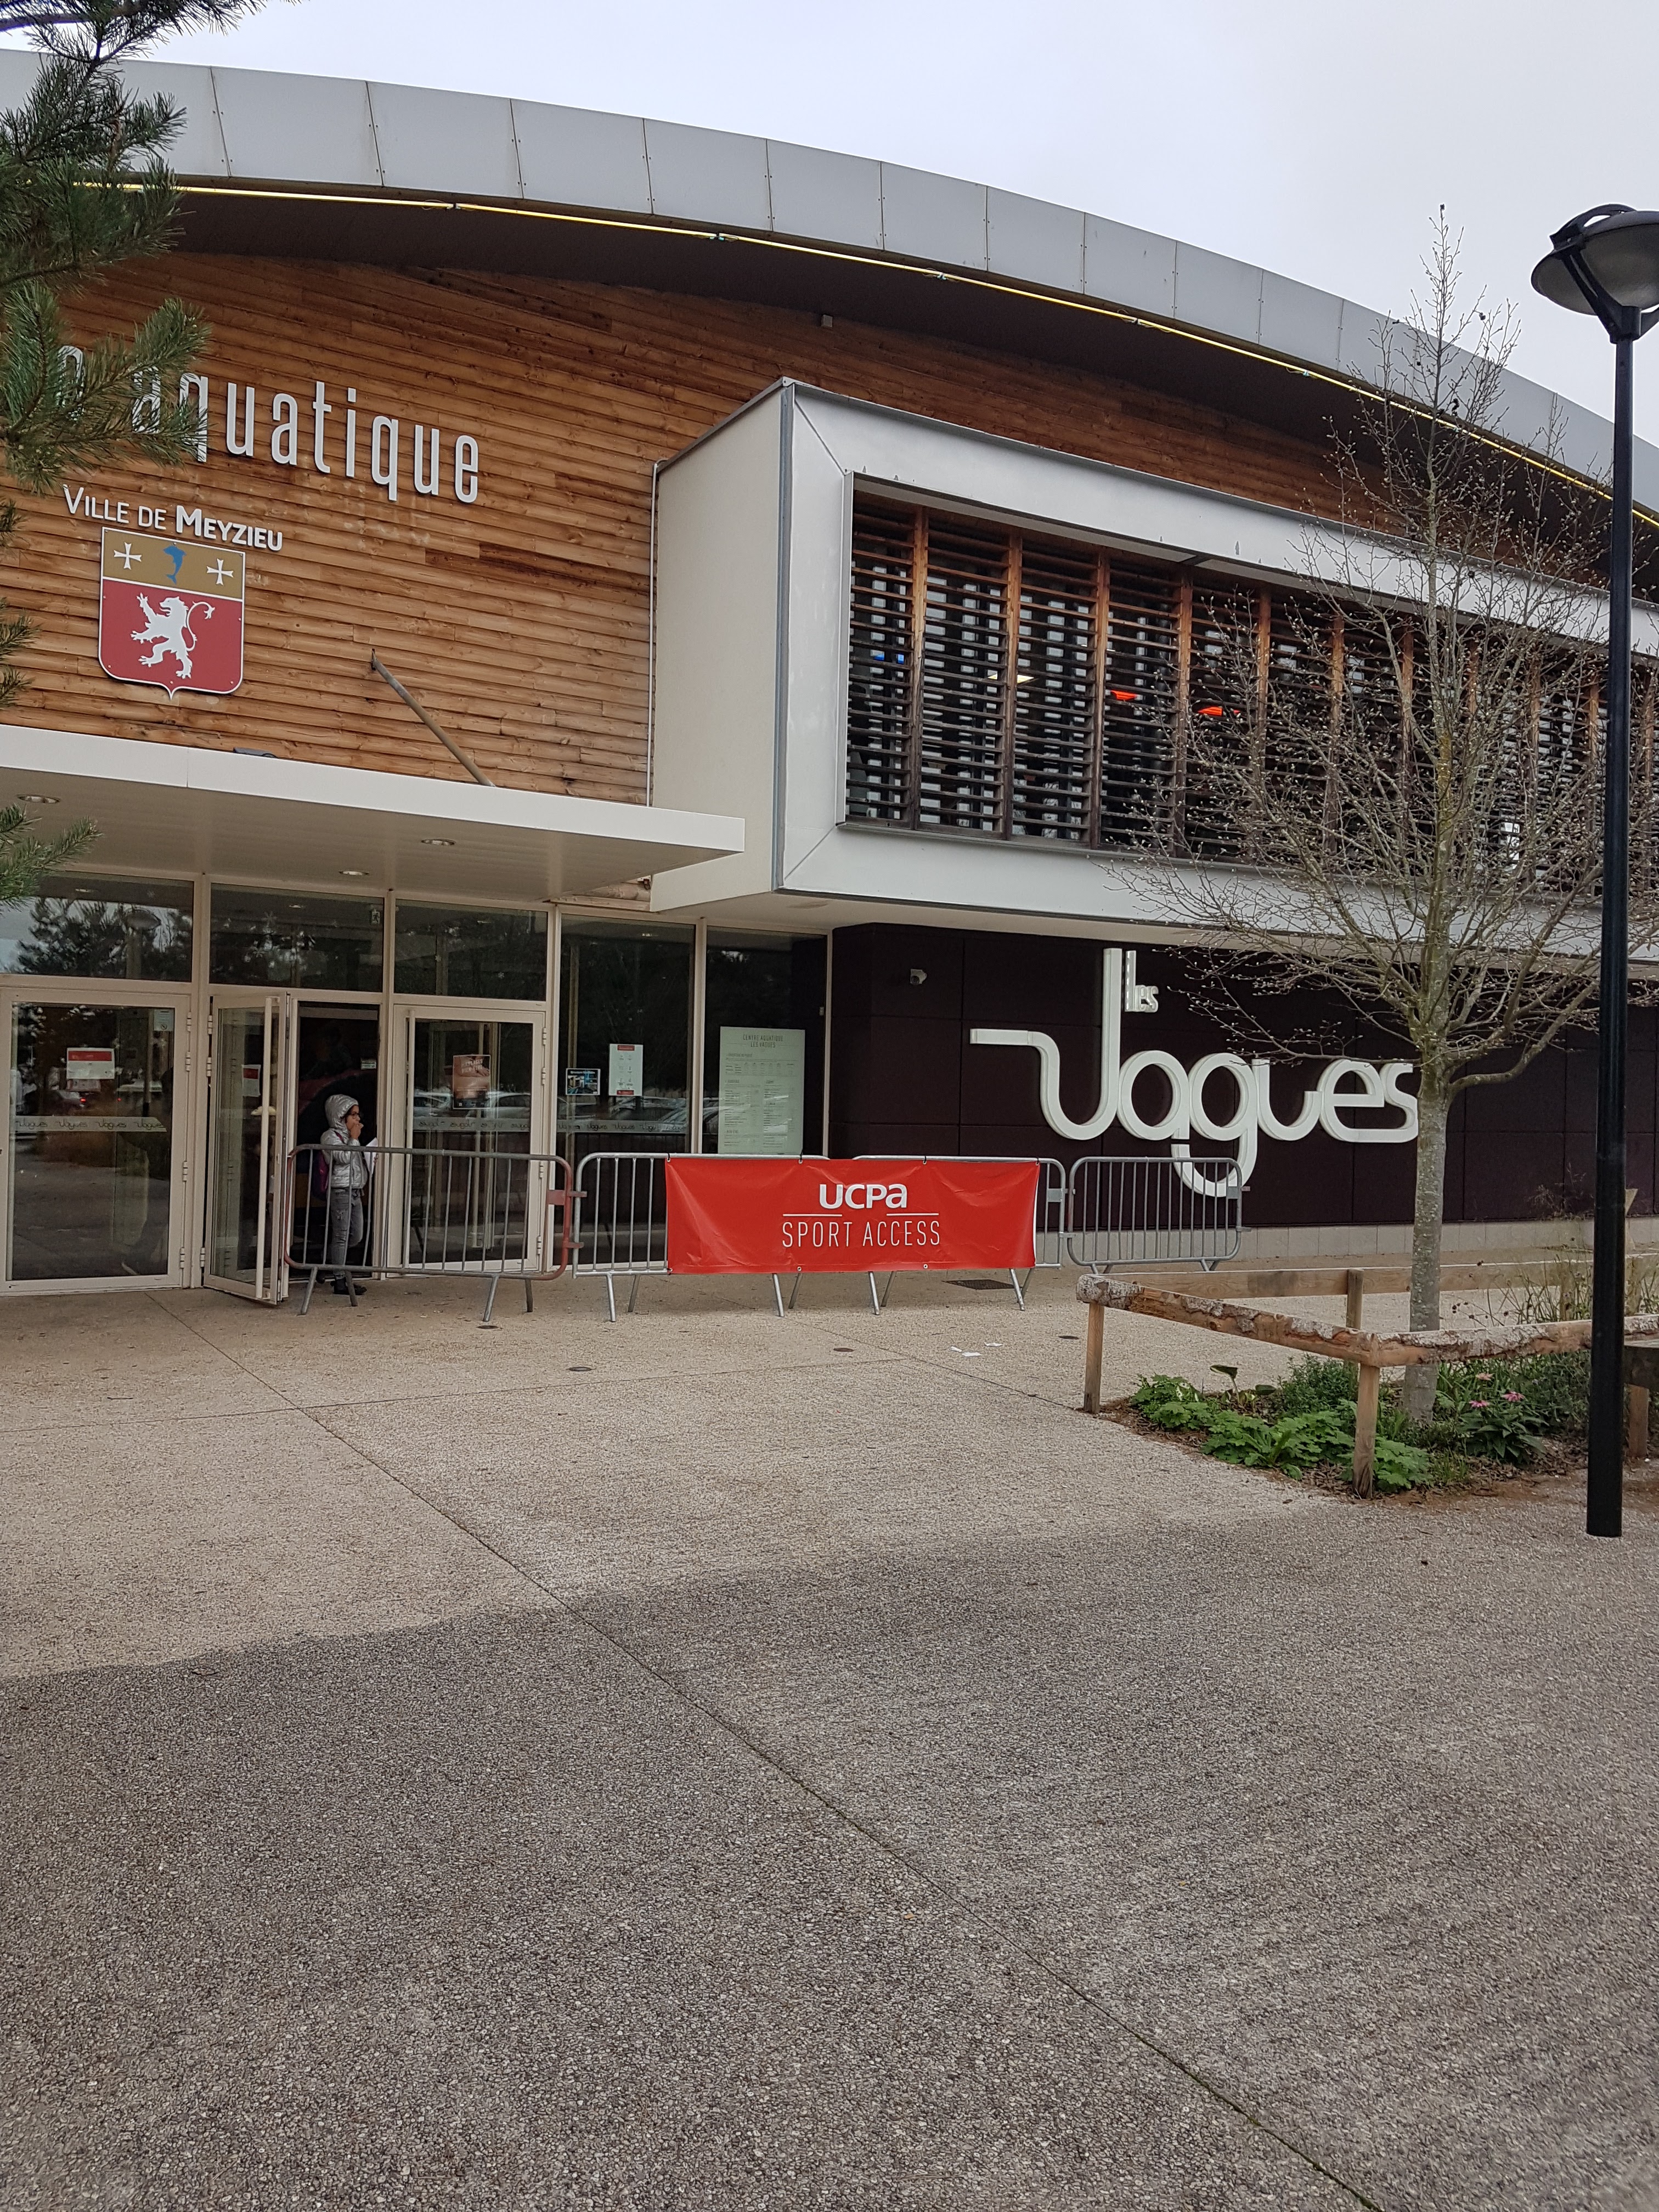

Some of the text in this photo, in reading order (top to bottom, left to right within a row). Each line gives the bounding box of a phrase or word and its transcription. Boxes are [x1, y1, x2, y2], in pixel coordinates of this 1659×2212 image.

[132, 365, 479, 504] aquatique
[782, 1220, 940, 1248] SPORT ACCESS
